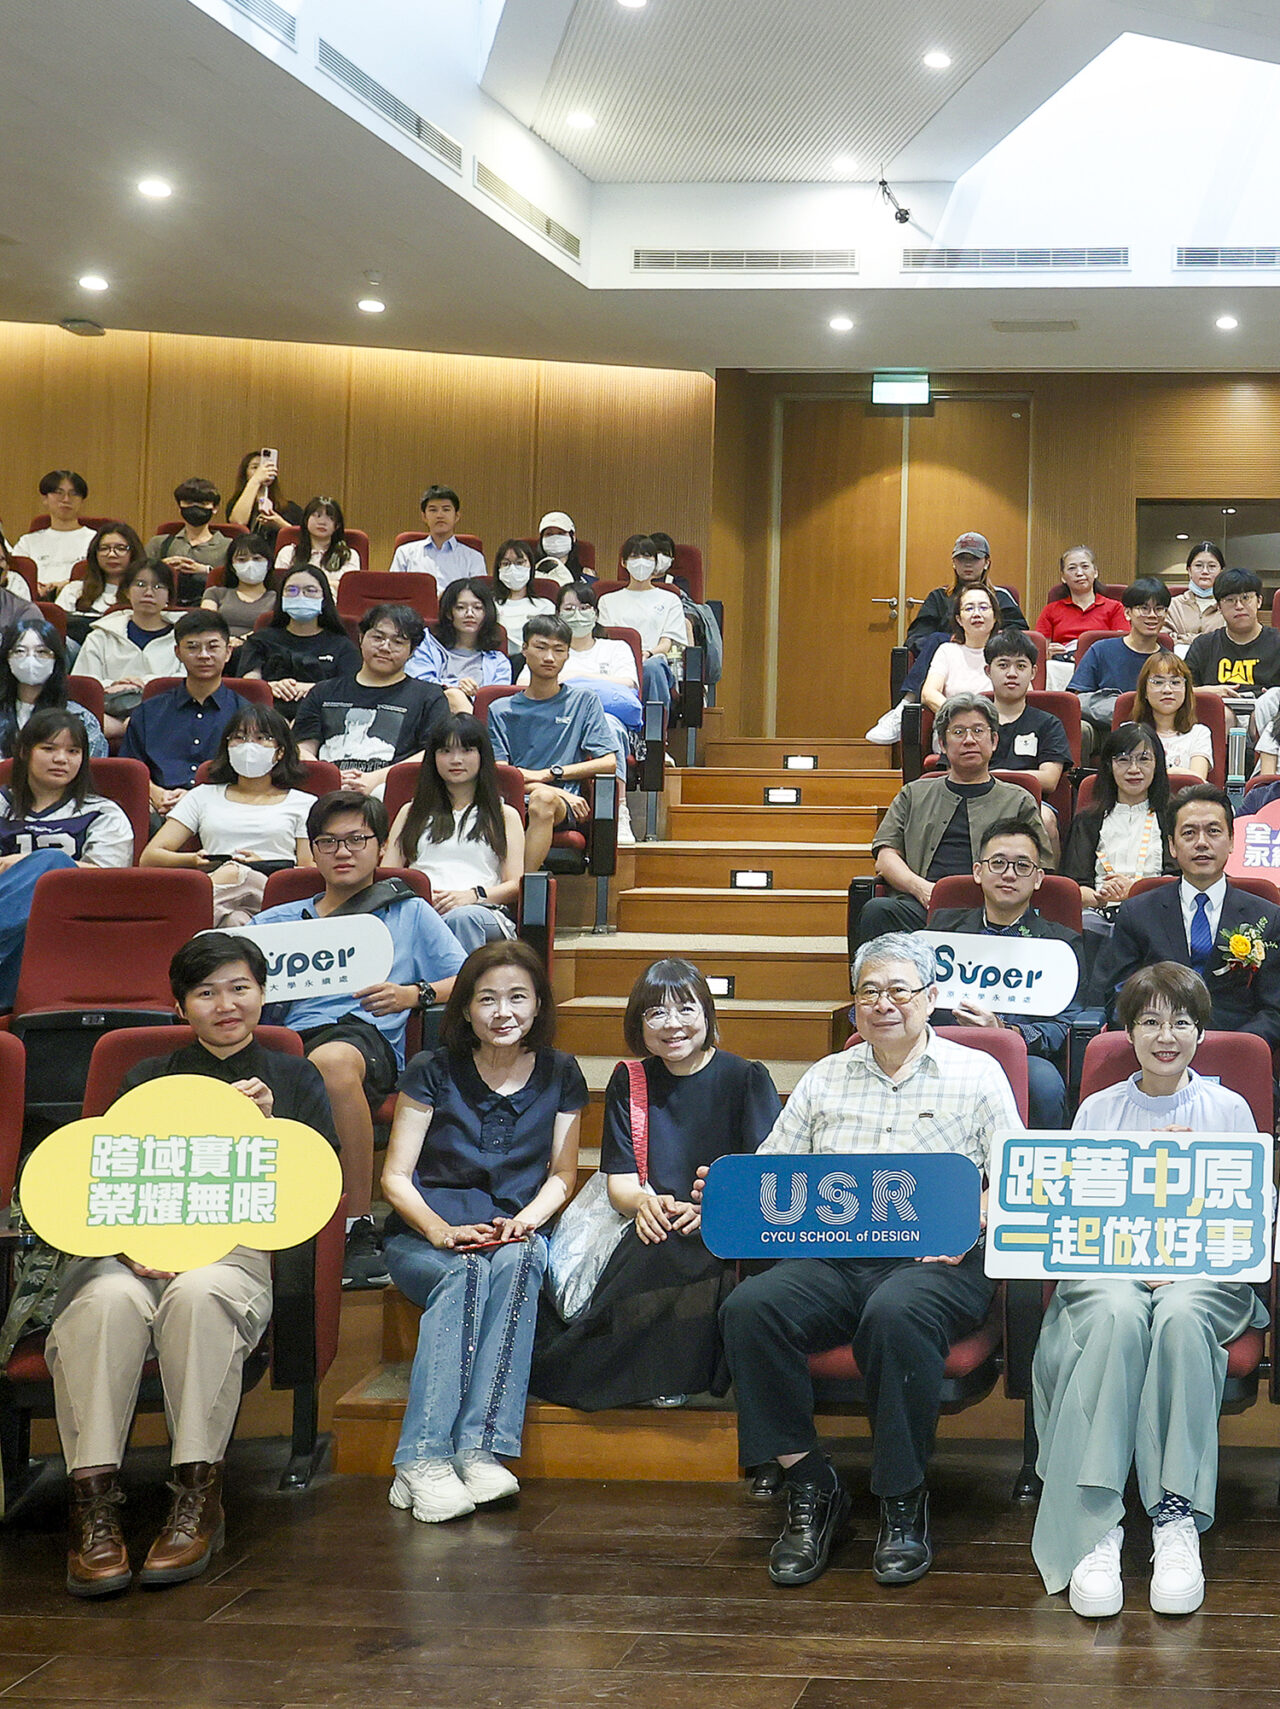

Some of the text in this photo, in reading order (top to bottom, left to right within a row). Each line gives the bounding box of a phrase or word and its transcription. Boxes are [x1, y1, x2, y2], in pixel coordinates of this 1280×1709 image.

[1218, 657, 1255, 685] CAT
[267, 947, 355, 977] uper
[935, 944, 1043, 988] Super
[91, 1135, 278, 1177] 跨域實作
[87, 1181, 277, 1226] 榮耀無限
[760, 1170, 919, 1225] USR
[1006, 1146, 1254, 1217] 跟著中原
[761, 1230, 920, 1243] CYCU SCHOOL of DESIGN
[1001, 1215, 1254, 1268] 一起做好事
